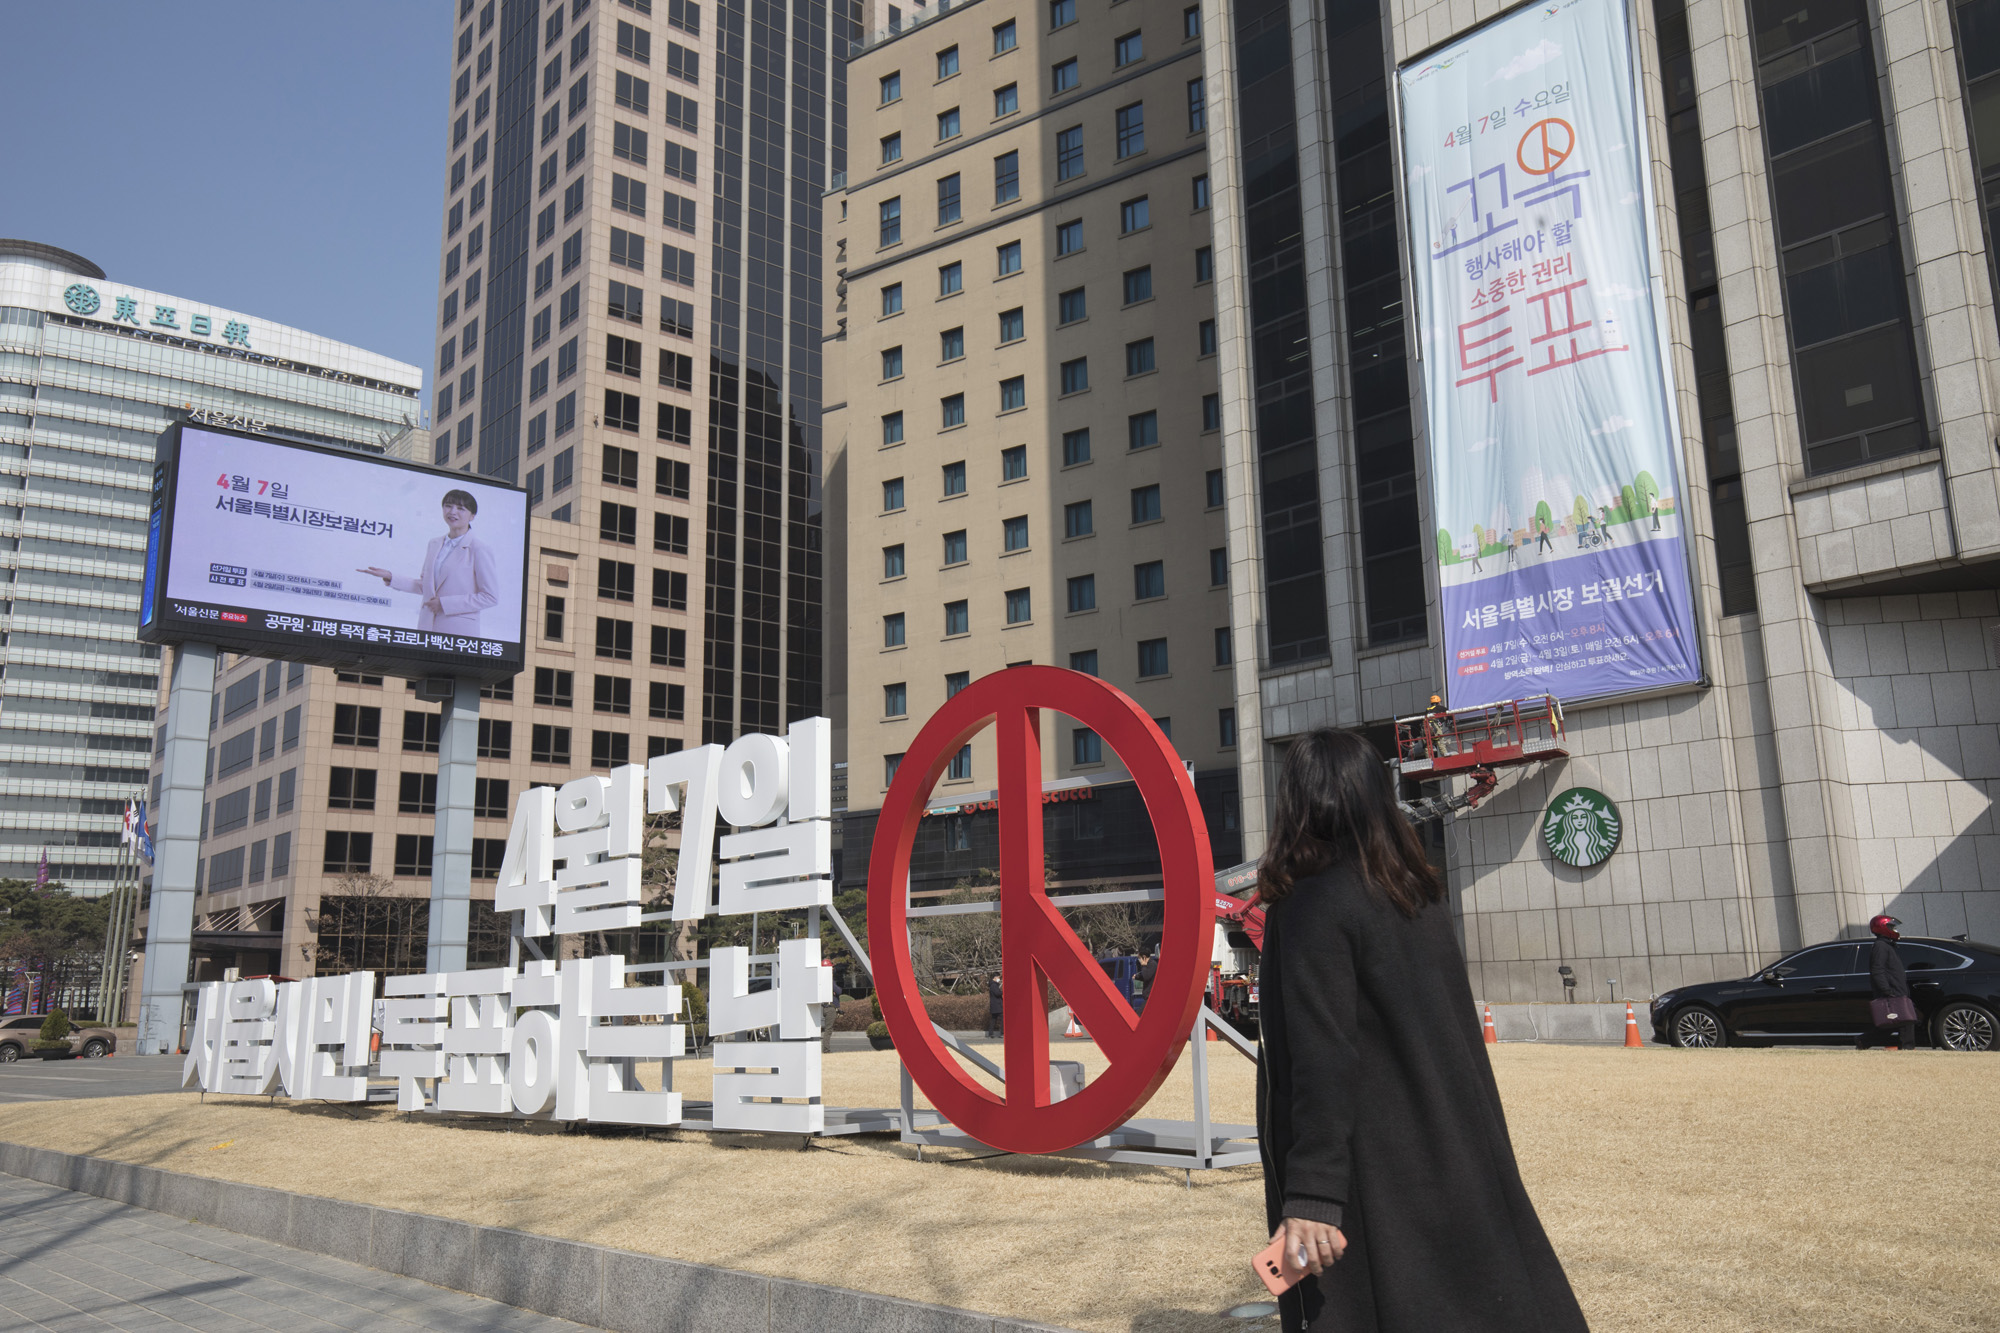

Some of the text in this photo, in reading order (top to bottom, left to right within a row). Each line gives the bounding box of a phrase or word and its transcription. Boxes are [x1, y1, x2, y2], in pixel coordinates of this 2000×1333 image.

[1444, 81, 1570, 148] 4월 7일 수요일
[1465, 220, 1573, 281] 행사해야 할
[1470, 252, 1572, 310] 소중한 권리
[112, 294, 251, 348] 東亞日報
[1455, 278, 1629, 403] 투표
[188, 407, 268, 435] 서울신문
[216, 473, 288, 500] 4월 7일
[215, 495, 393, 538] 서울특별시장보궐선거
[211, 564, 246, 576] 선거일 투표
[287, 575, 300, 583] 오전
[222, 612, 246, 622] 주요뉴스
[1462, 569, 1664, 630] 서울특별시장 보궐선거
[339, 623, 364, 640] 목적
[366, 627, 391, 643] 출국
[393, 630, 429, 647] 코로나
[430, 634, 453, 651] 백신
[455, 638, 478, 653] 우선
[480, 641, 503, 657] 접종
[1490, 642, 1503, 654] 4월
[1532, 633, 1549, 645] 오전
[1589, 623, 1605, 635] 8시
[1490, 658, 1503, 669] 4월
[1585, 640, 1603, 652] 매일
[1605, 636, 1622, 648] 오전
[495, 716, 833, 937] 4월 7일
[182, 937, 824, 1133] 서울시민 투표하는 날
